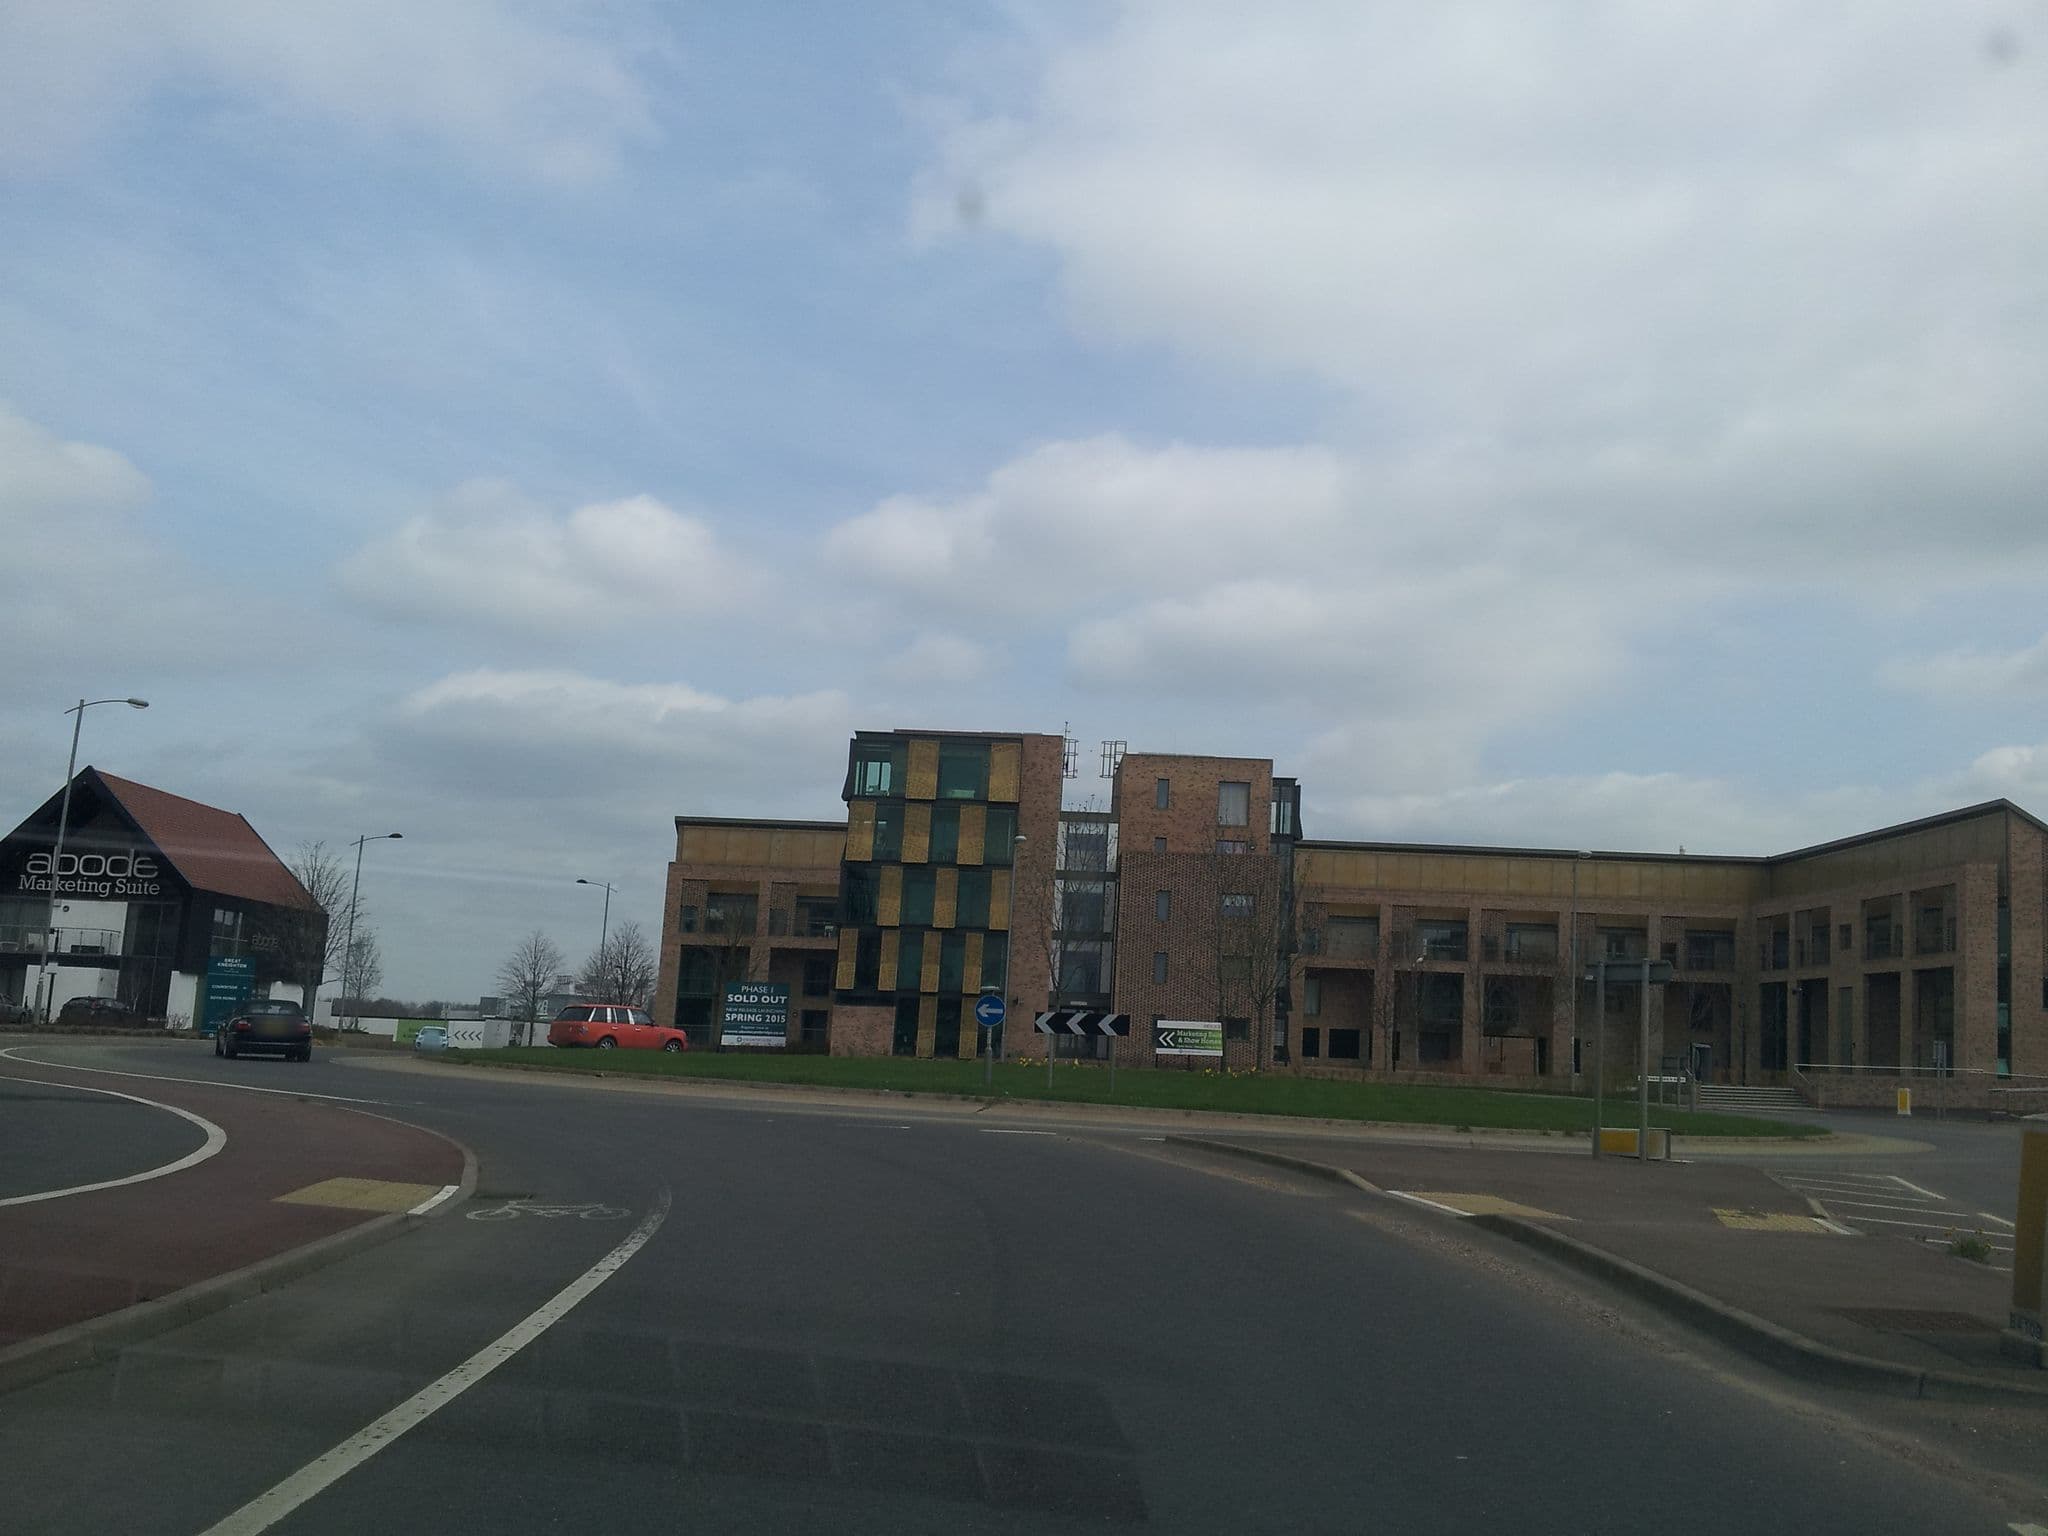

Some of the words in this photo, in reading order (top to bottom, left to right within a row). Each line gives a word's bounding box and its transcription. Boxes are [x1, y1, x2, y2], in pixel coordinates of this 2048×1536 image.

[26, 846, 159, 878] abode
[18, 875, 112, 897] Marketing
[115, 878, 161, 895] Suite
[741, 985, 769, 993] PHASE
[727, 994, 758, 1003] SOLD
[761, 995, 788, 1004] OUT
[725, 1013, 762, 1022] SPRING
[765, 1014, 786, 1023] 2015
